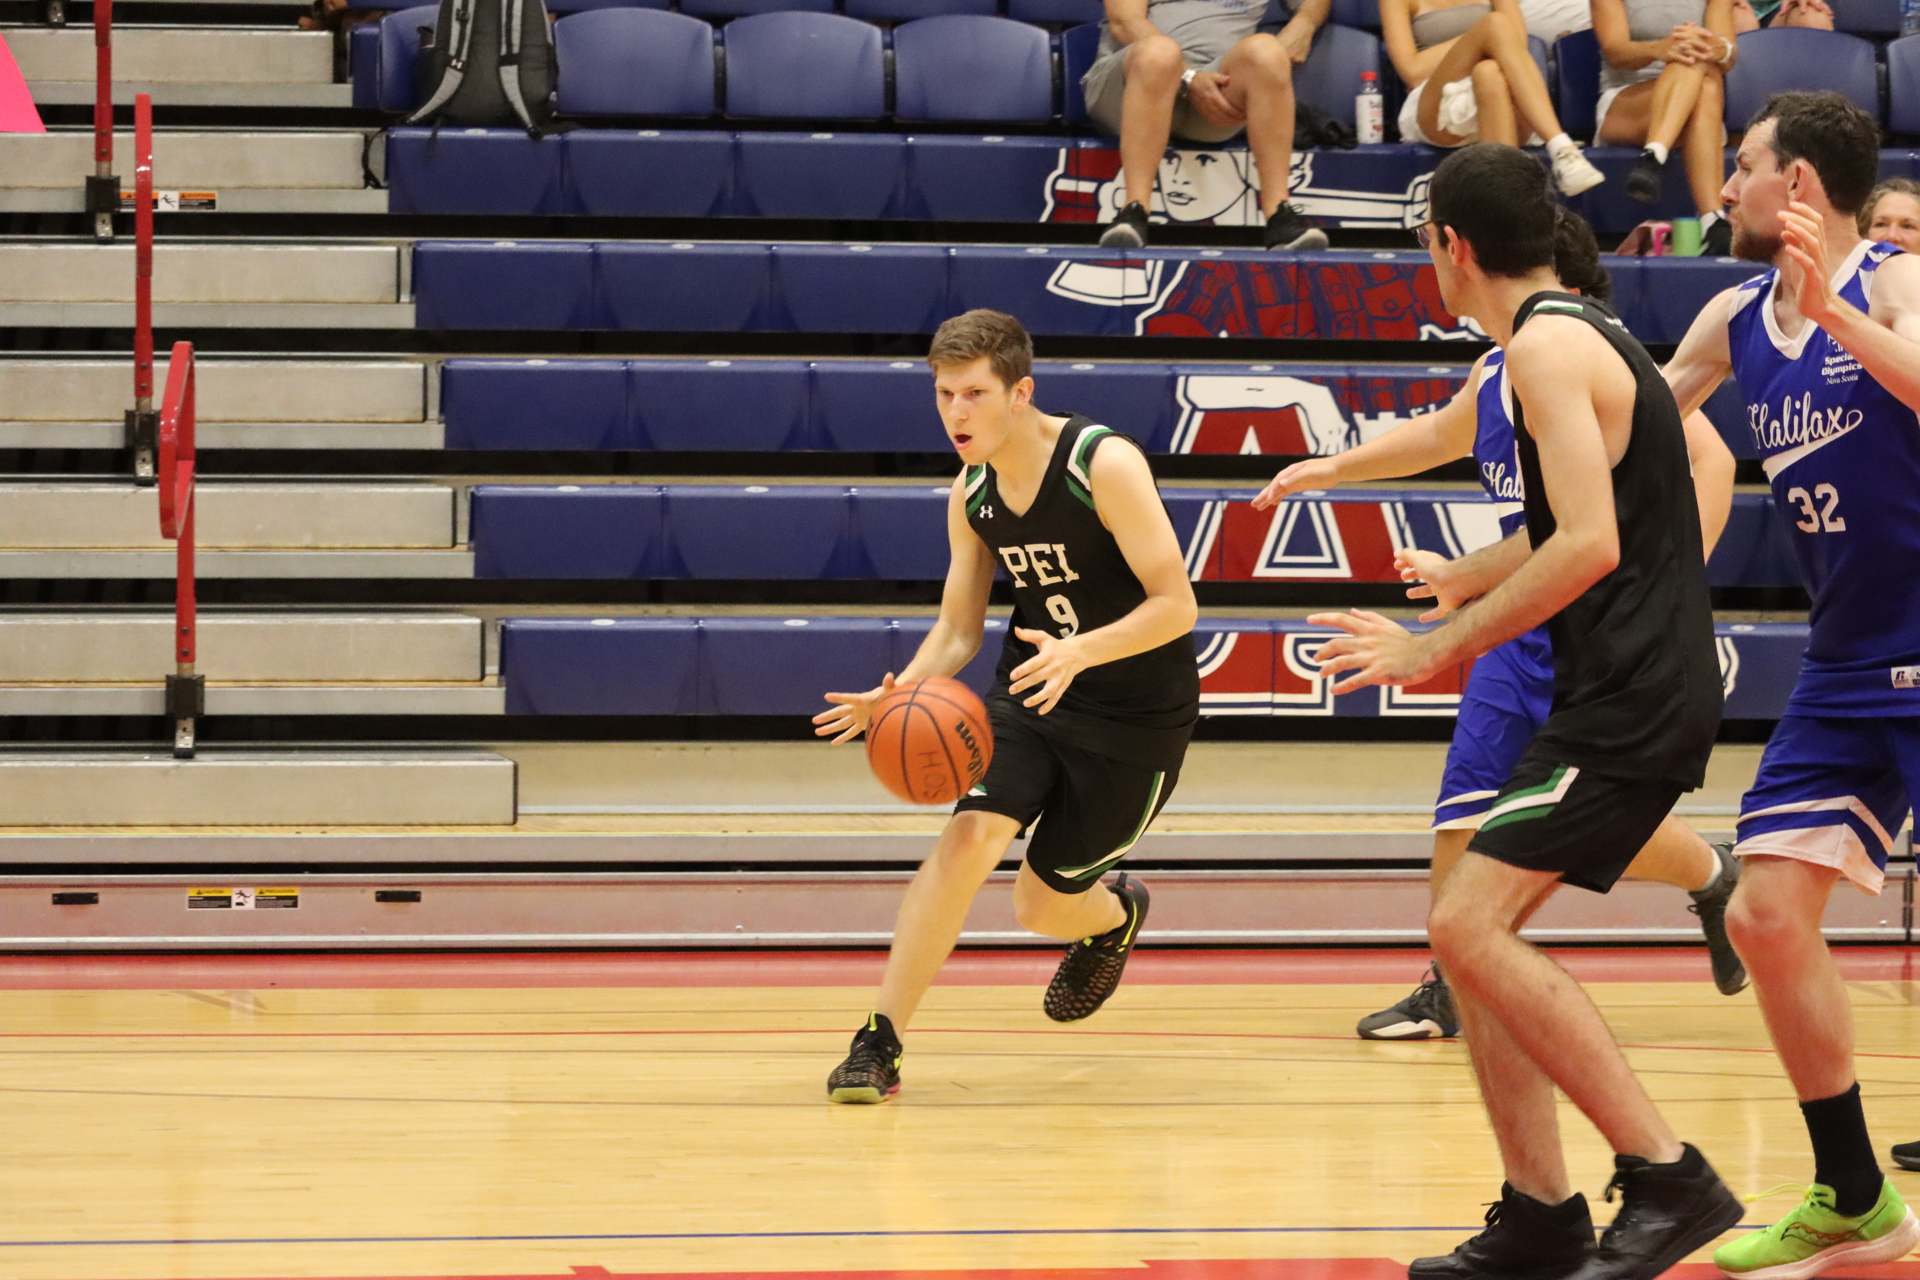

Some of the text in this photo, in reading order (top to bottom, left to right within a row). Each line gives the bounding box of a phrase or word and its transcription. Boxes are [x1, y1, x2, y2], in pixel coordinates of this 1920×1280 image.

[1821, 362, 1863, 376] Olympics
[1824, 352, 1854, 366] Specia
[1826, 373, 1859, 385] Nova Scotia
[1747, 390, 1850, 449] Halifax
[1787, 482, 1846, 534] 32
[998, 543, 1080, 589] PEI
[1045, 593, 1079, 640] 9
